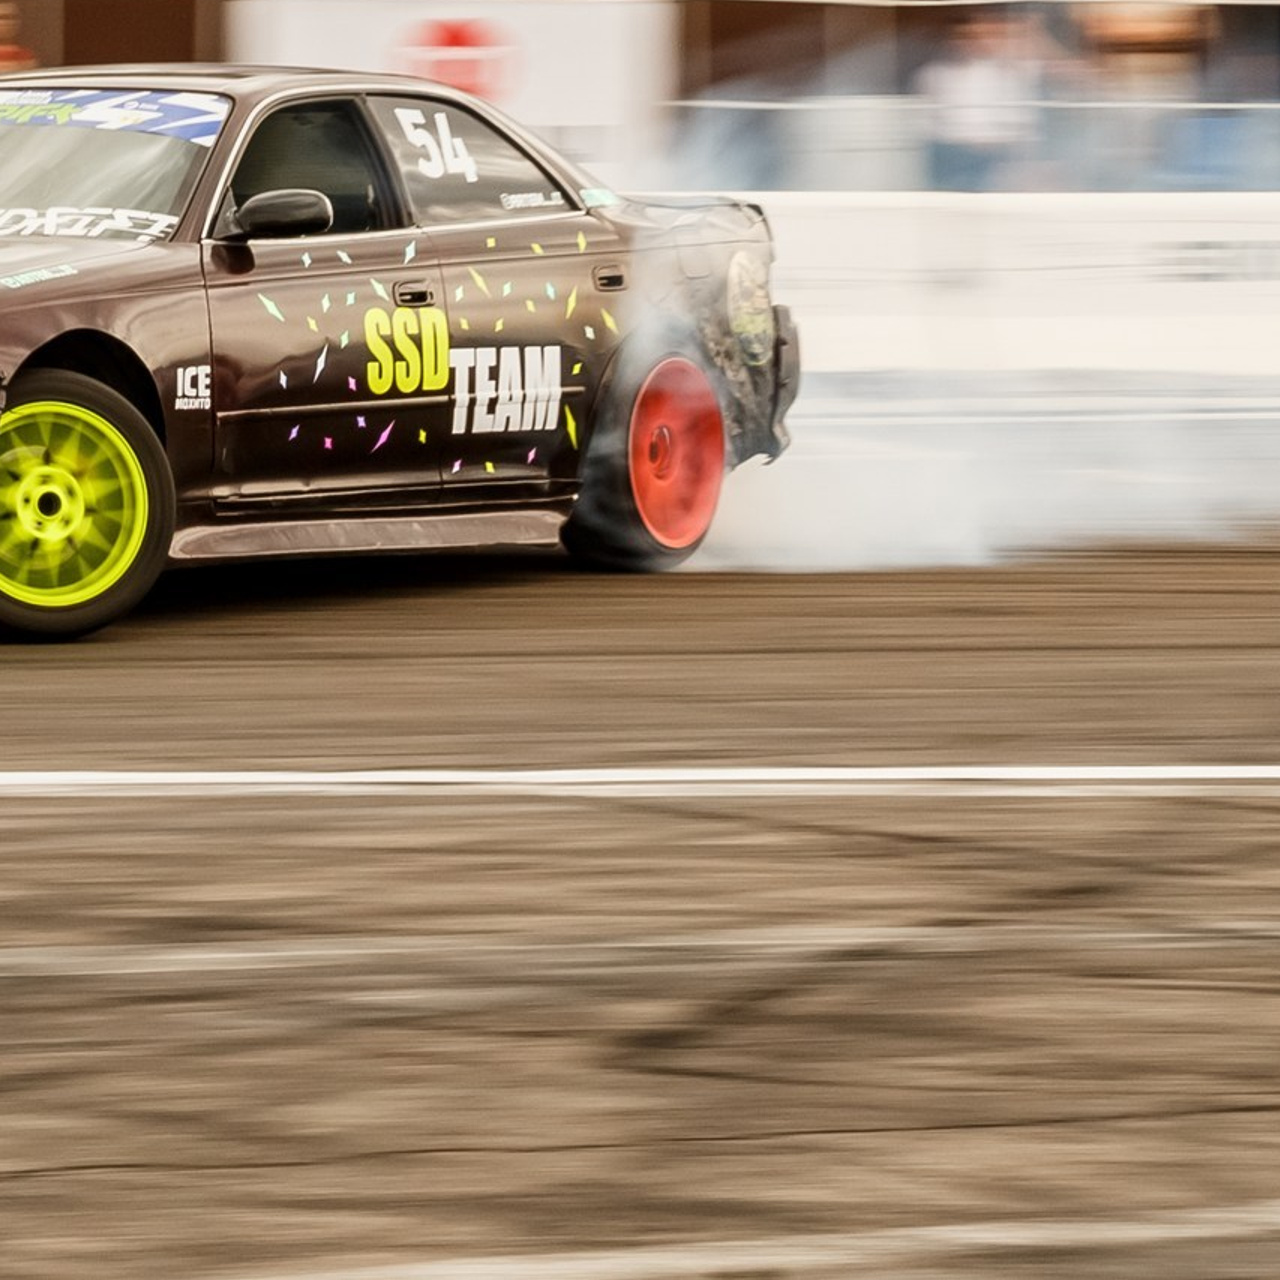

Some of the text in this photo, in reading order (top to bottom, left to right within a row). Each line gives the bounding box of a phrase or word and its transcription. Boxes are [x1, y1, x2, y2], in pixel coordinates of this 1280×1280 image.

[394, 107, 479, 184] 54
[176, 364, 212, 398] ICE
[364, 306, 450, 395] SSD
[449, 345, 562, 435] TEAM
